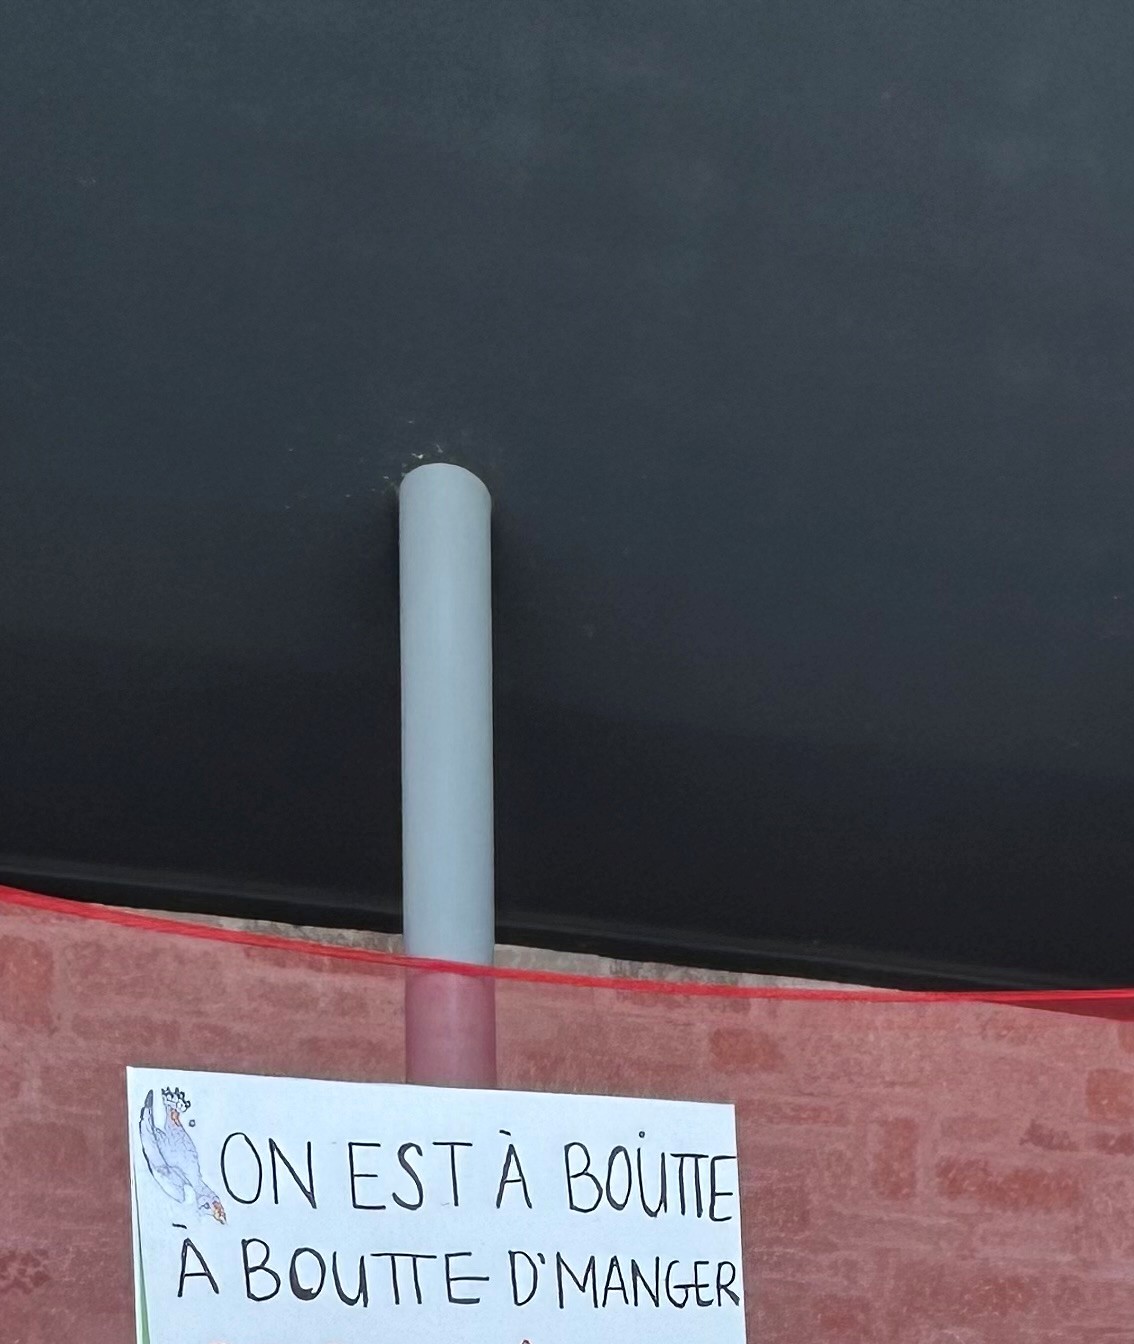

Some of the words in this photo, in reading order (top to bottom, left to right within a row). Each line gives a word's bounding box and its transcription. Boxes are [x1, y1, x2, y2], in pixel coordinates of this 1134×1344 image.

[220, 1131, 317, 1208] ON
[349, 1141, 473, 1211] EST
[497, 1130, 531, 1210] À
[172, 1222, 219, 1299] À
[241, 1236, 490, 1308] BOUTTE
[508, 1250, 741, 1310] D'MANGER
